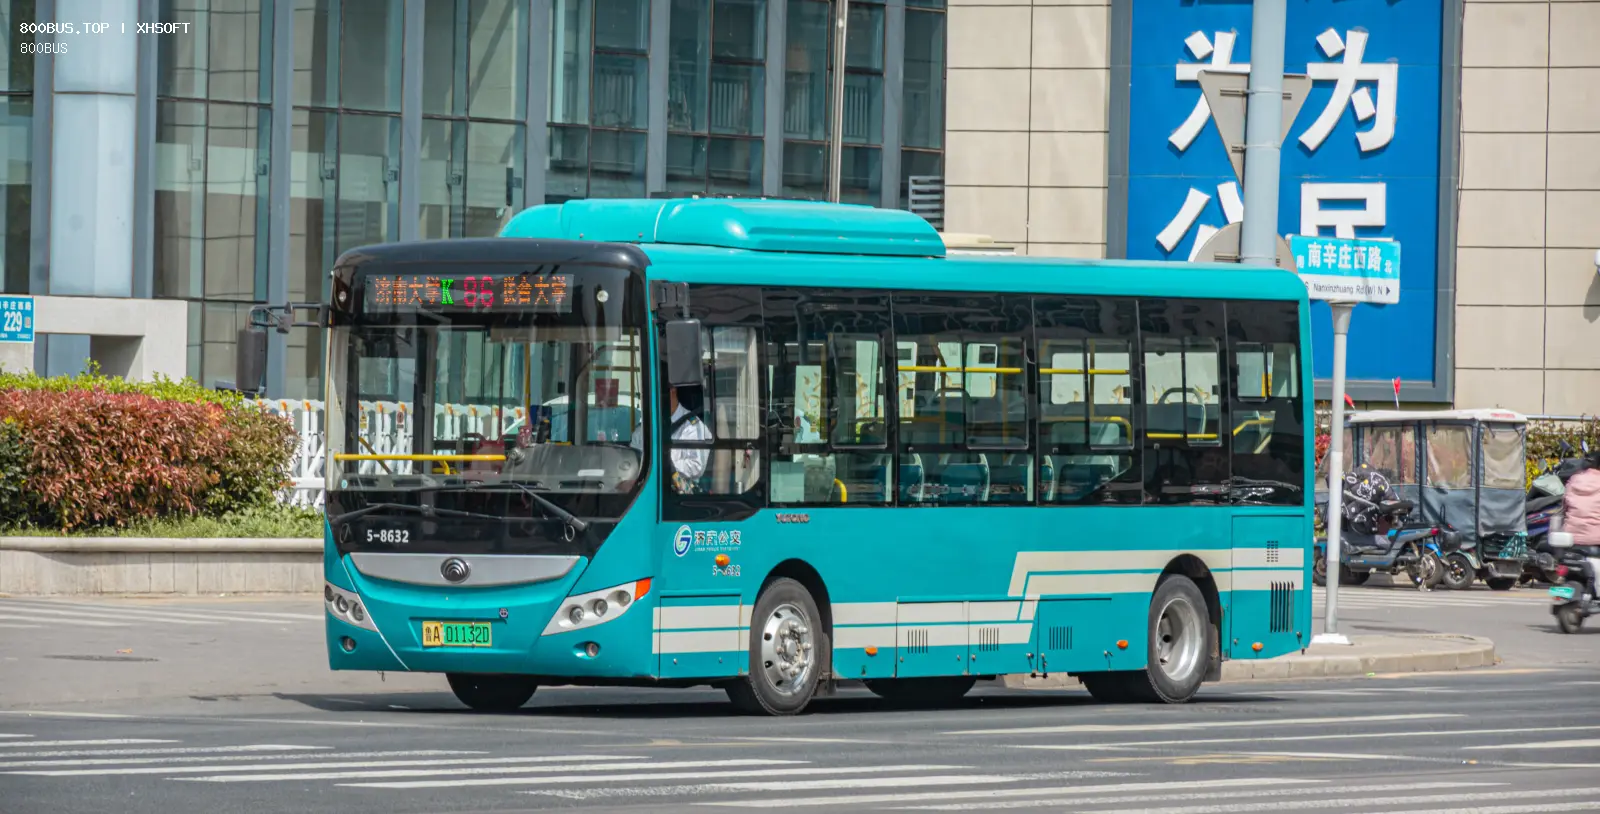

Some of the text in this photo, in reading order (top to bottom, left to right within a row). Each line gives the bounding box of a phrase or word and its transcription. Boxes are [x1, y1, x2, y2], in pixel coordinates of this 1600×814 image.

[1308, 241, 1381, 272] 南辛庄西路
[375, 276, 440, 305] 济南大学
[1313, 283, 1354, 295] Nanxinzhuang
[4, 311, 22, 332] 229
[366, 529, 409, 543] 5-8632
[694, 529, 741, 545] 济南公交
[712, 564, 741, 576] 5-632
